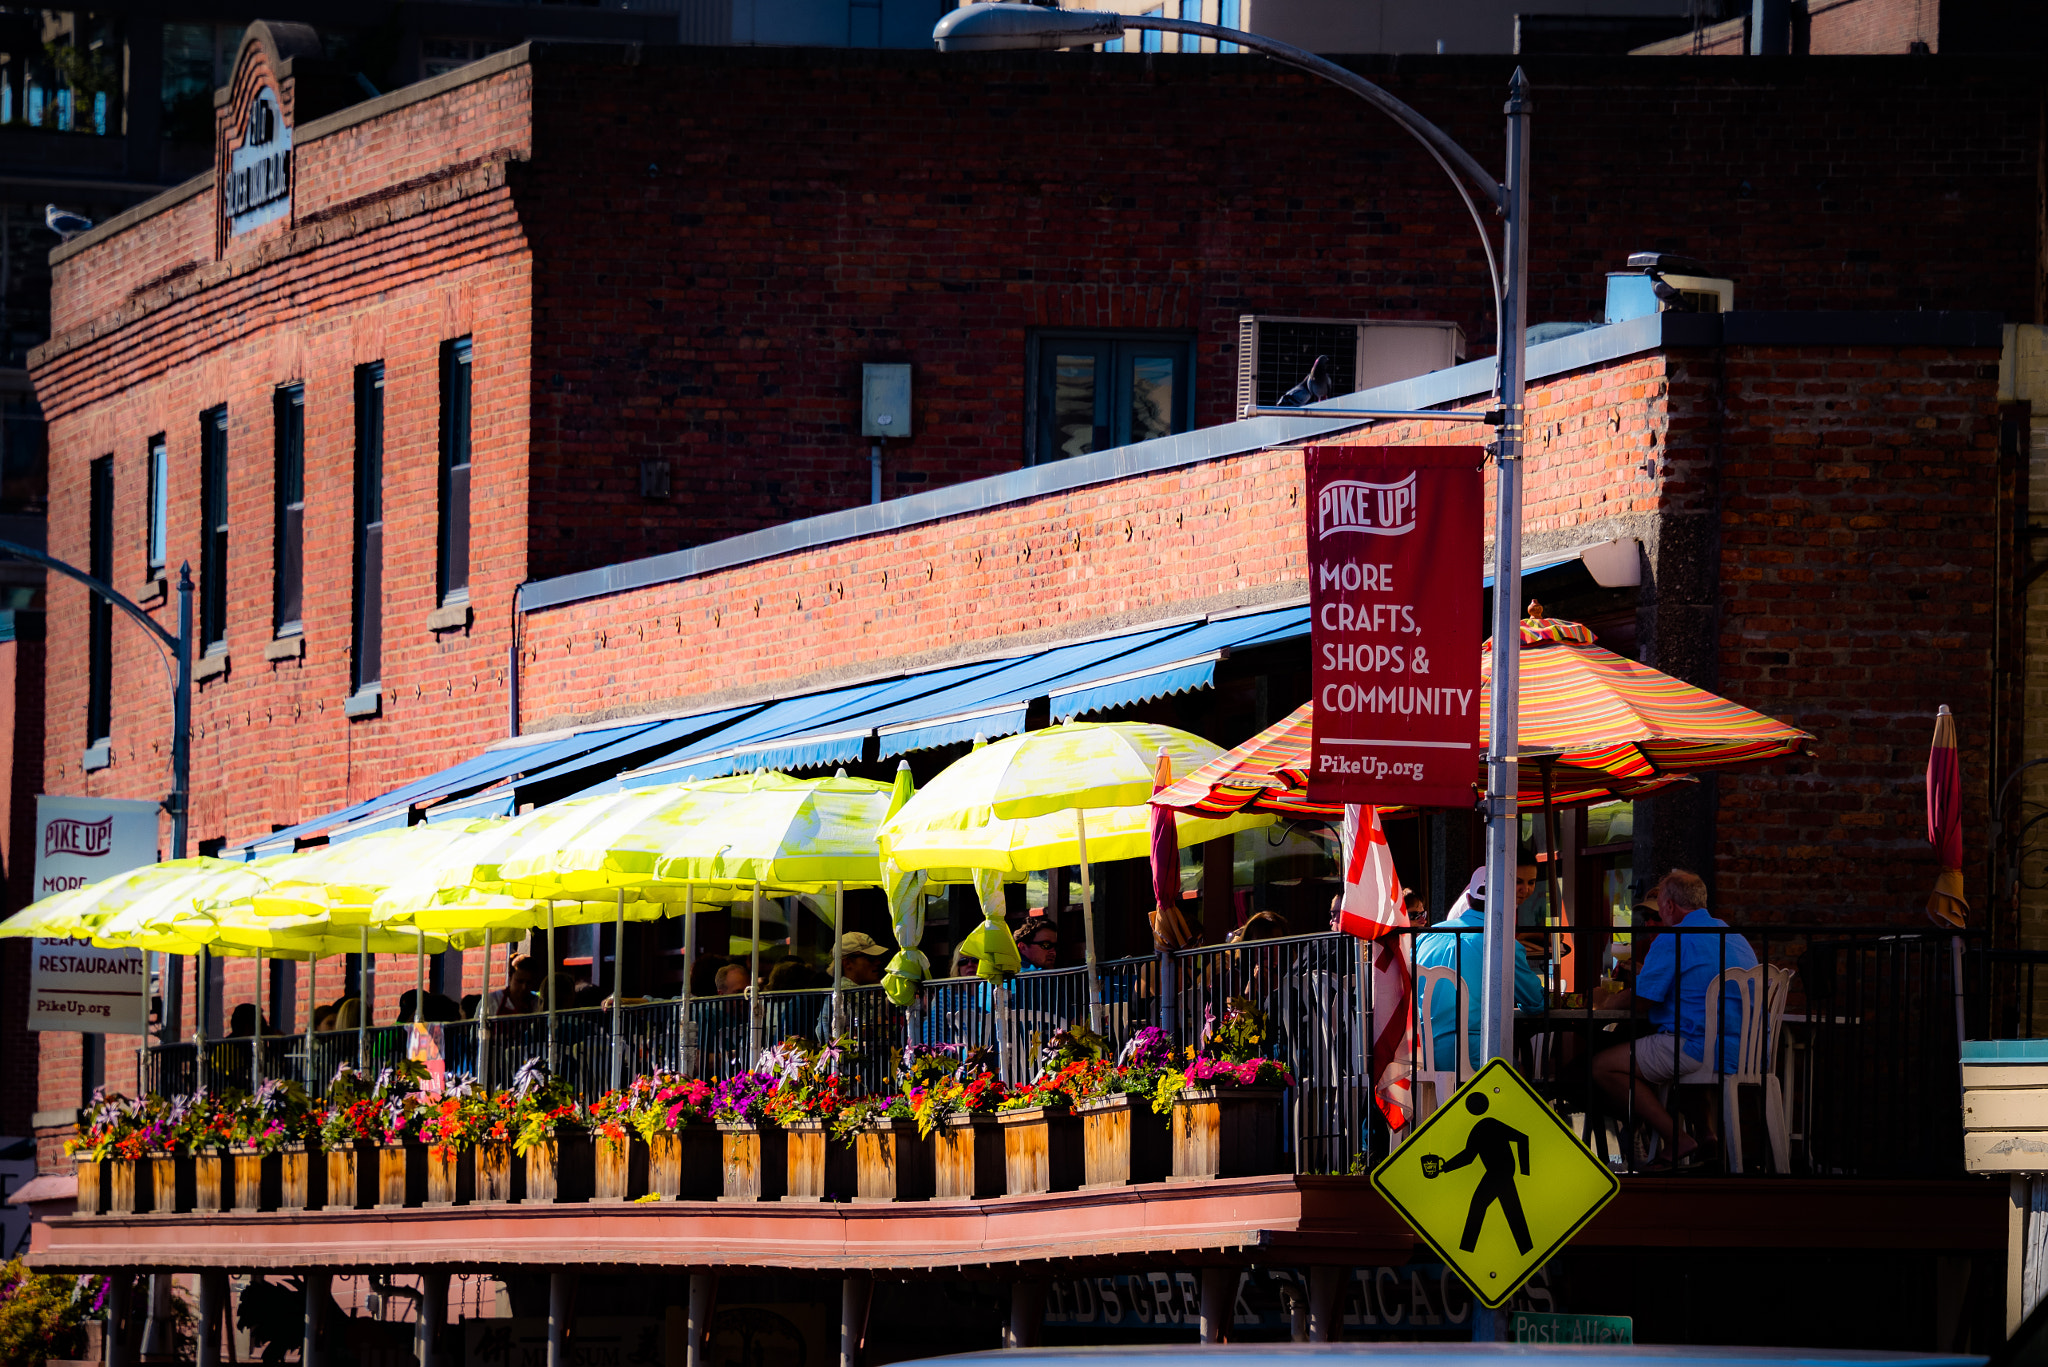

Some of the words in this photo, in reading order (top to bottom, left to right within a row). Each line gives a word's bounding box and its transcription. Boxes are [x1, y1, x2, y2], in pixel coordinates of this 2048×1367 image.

[1319, 486, 1371, 533] PIKE
[1378, 480, 1416, 527] UP!
[1320, 563, 1393, 591] MORE
[1321, 603, 1422, 636] CRAFTS,
[1322, 643, 1405, 673] SHOPS
[1412, 646, 1430, 674] &
[1322, 684, 1472, 716] COMMUNITY
[1319, 755, 1424, 781] PikeUp.org
[45, 822, 80, 853] PIKE
[85, 822, 113, 851] UP!
[39, 955, 144, 974] RESTAURANTS
[37, 1000, 111, 1017] PikeUp.org
[1131, 1271, 1260, 1325] GREK
[1517, 1316, 1560, 1344] Post
[1572, 1319, 1625, 1344] Alley
